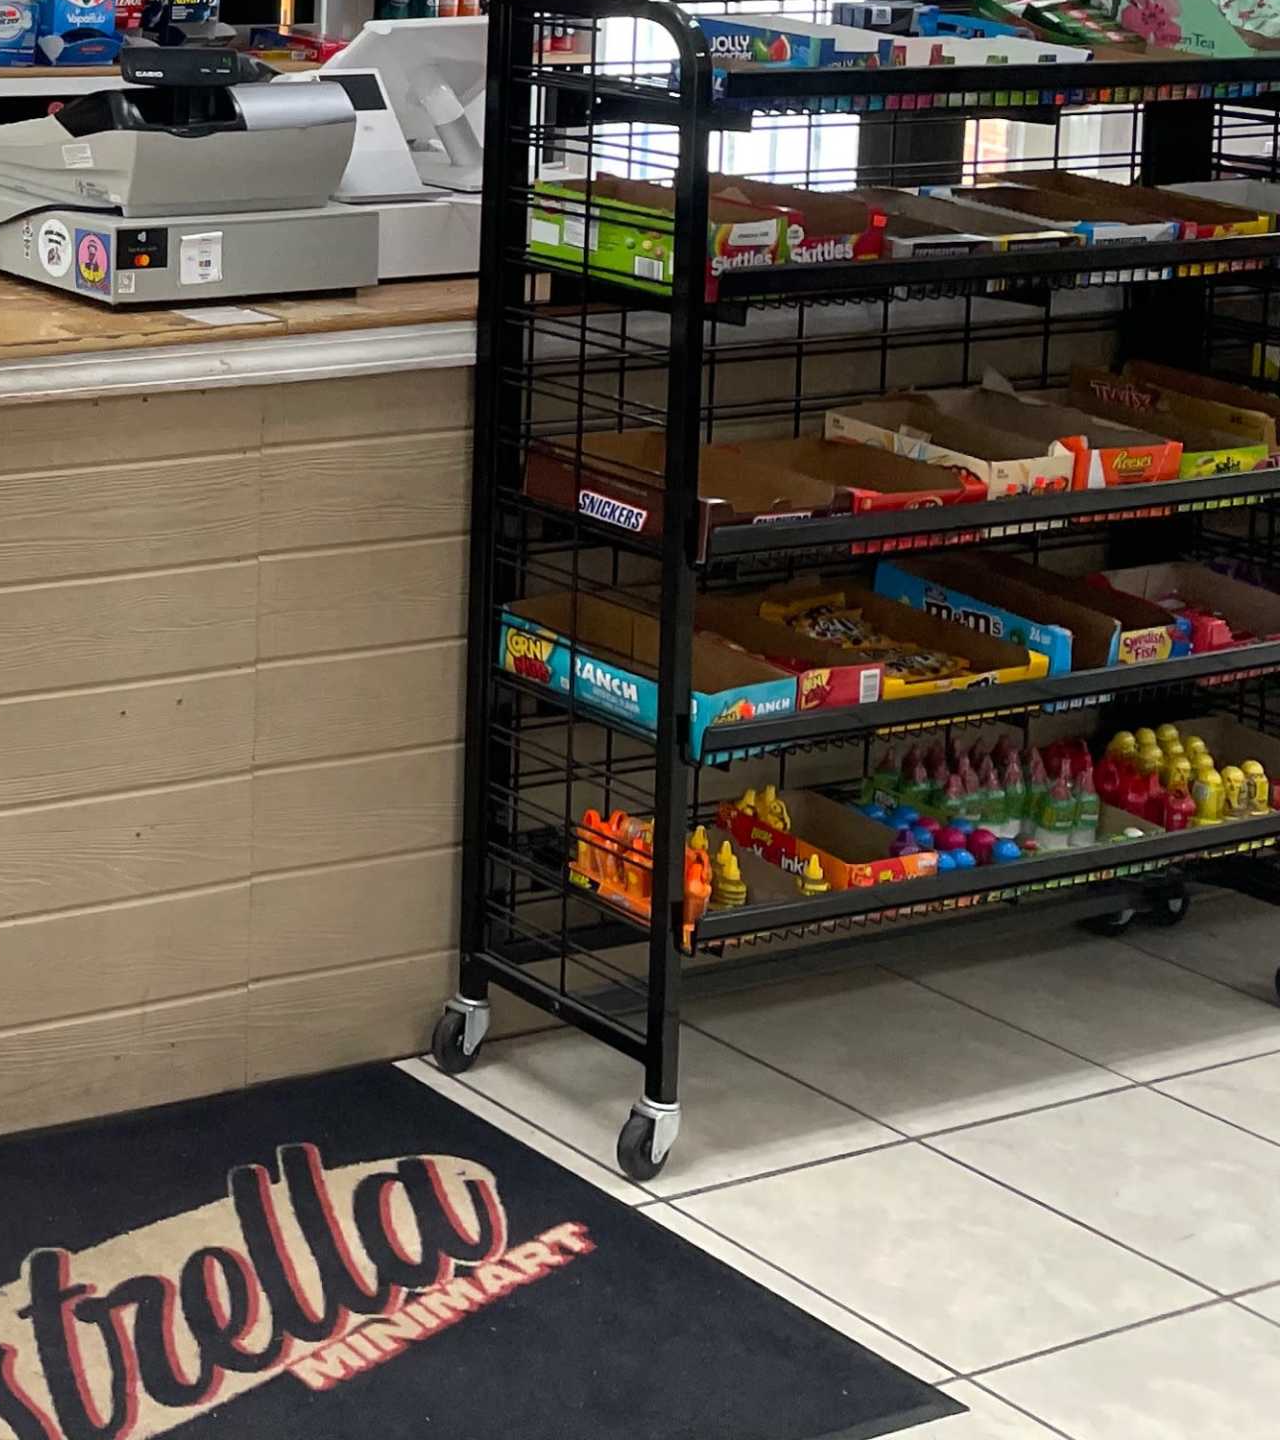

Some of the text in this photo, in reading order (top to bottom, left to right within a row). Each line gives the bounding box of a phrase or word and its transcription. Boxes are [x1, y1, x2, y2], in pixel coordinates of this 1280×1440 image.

[710, 36, 750, 51] JOLLY
[1192, 33, 1215, 50] Tea
[791, 239, 854, 264] Skittles
[579, 494, 644, 530] SNICKERS
[506, 629, 542, 659] CORN
[1123, 633, 1168, 652] Swedish
[1134, 645, 1157, 659] Fish
[286, 1221, 596, 1392] MINIMART
